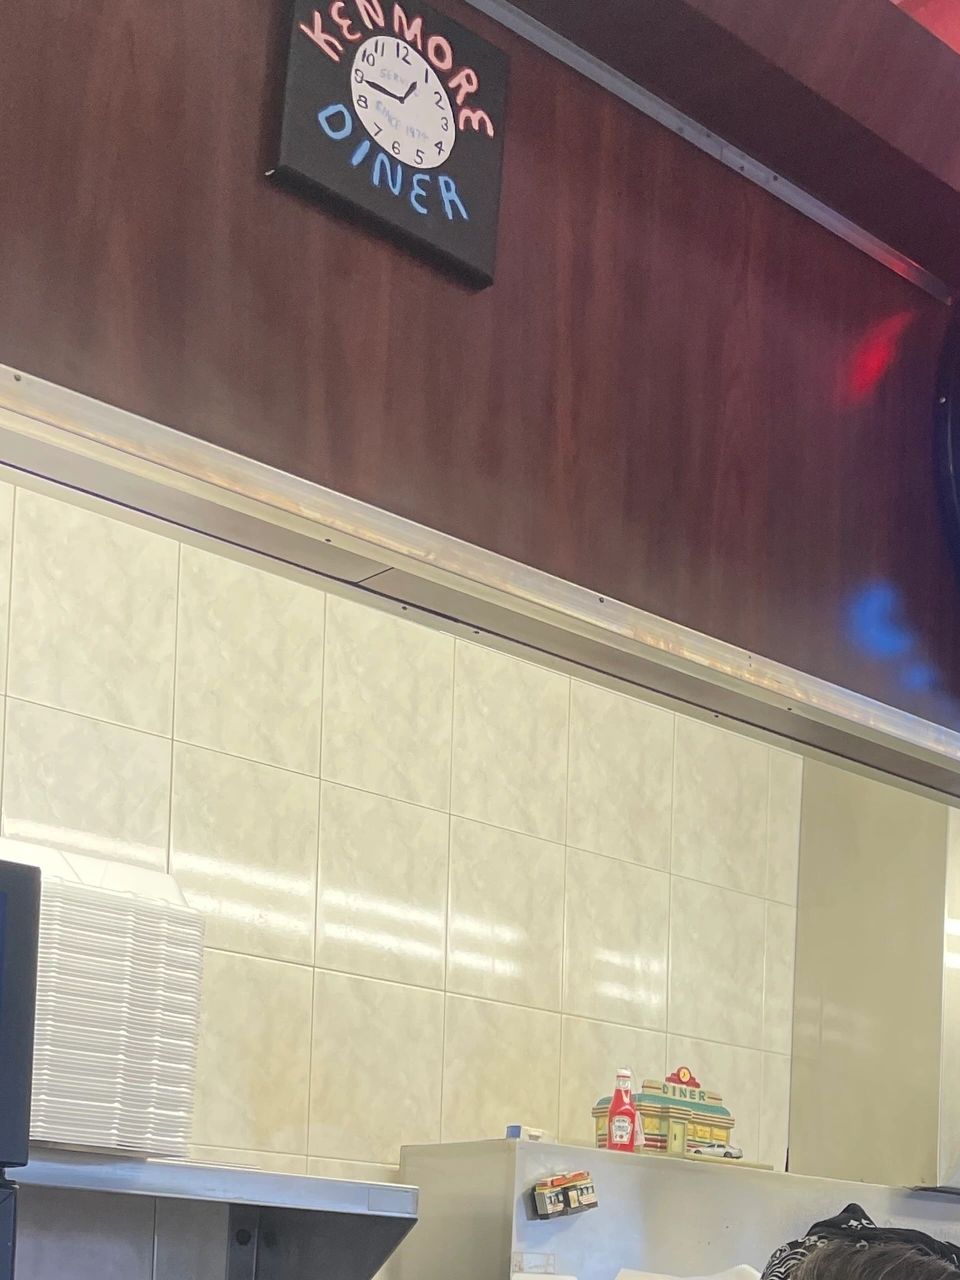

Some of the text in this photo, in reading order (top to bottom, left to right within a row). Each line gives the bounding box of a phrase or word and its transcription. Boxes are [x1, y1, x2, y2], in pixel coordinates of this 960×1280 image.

[361, 48, 375, 67] 10
[396, 41, 412, 66] 12
[300, 0, 494, 138] KENMORE
[357, 95, 368, 109] 8
[434, 91, 445, 110] 2
[374, 122, 383, 136] 7
[440, 116, 449, 132] 3
[392, 141, 400, 155] 6
[434, 140, 445, 156] 4
[318, 104, 468, 220] DINER
[414, 149, 424, 165] 5
[662, 1084, 706, 1101] DINER
